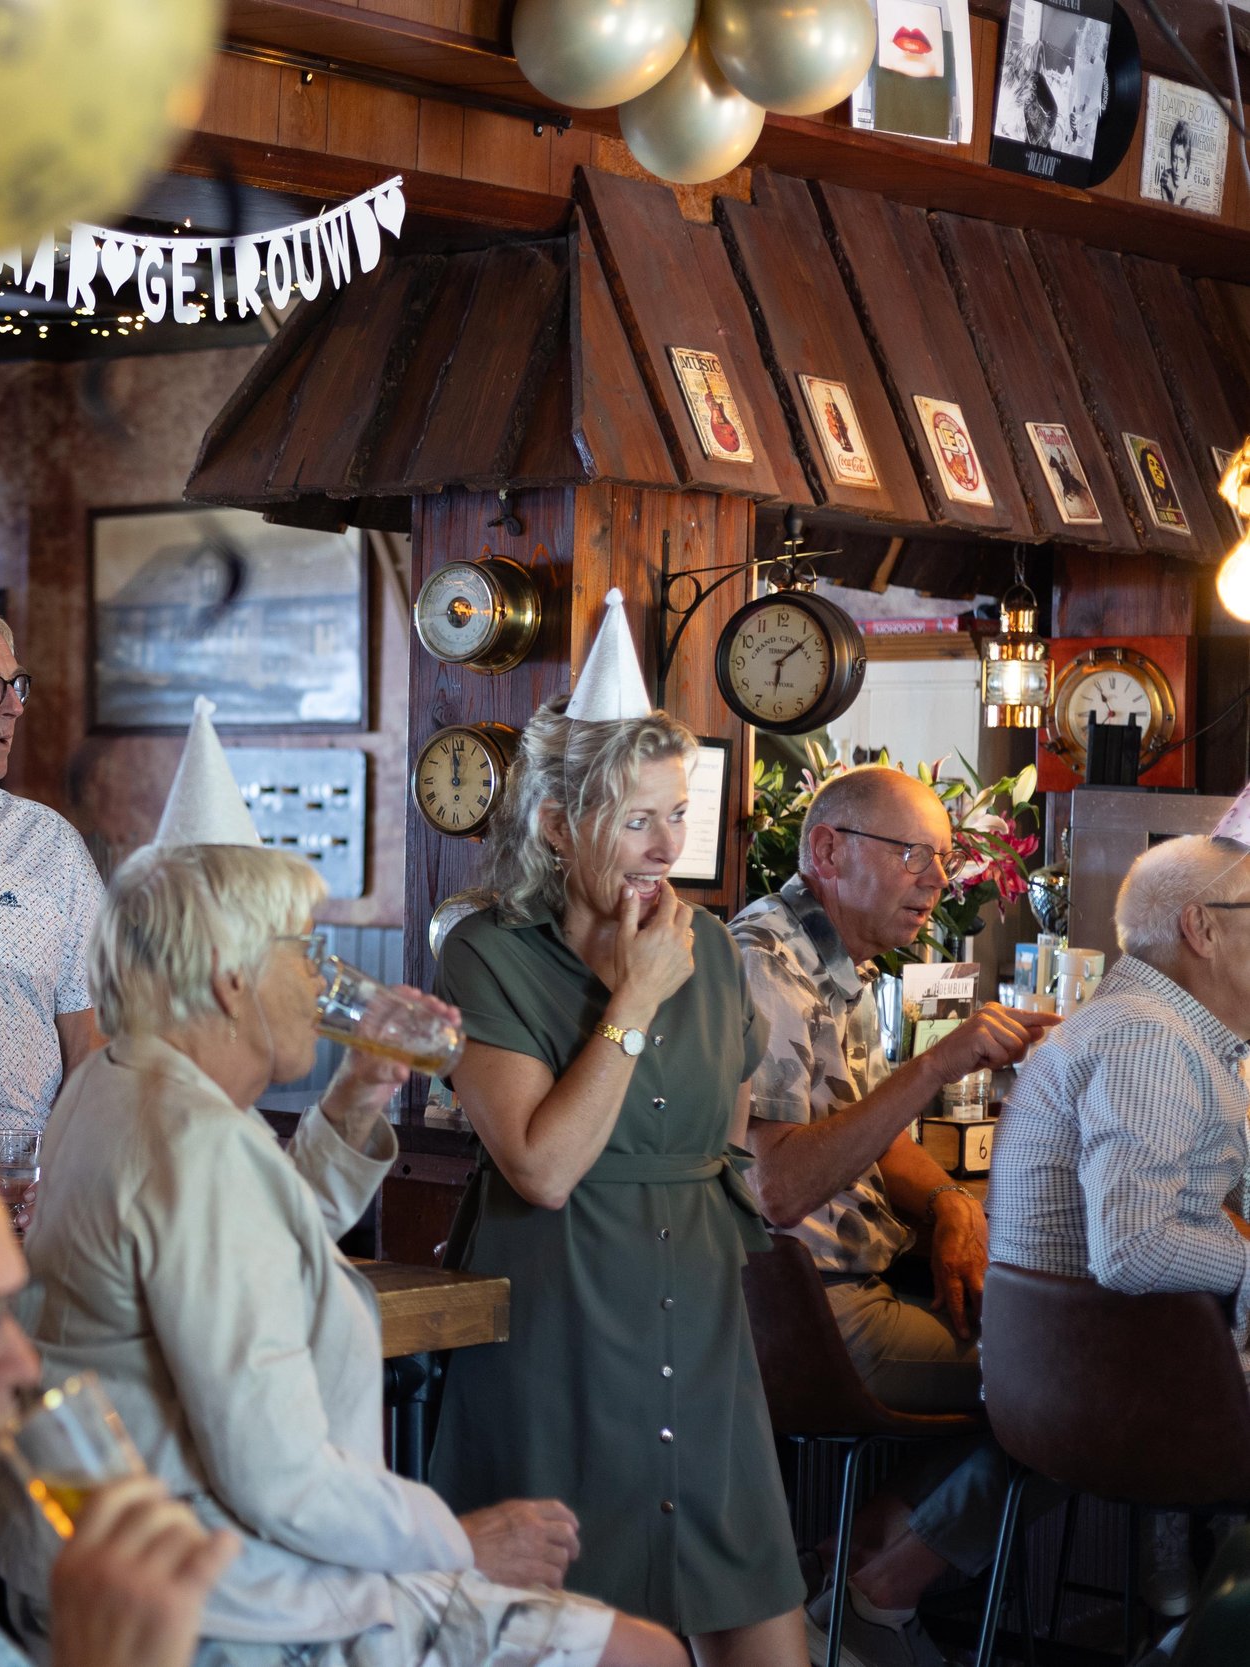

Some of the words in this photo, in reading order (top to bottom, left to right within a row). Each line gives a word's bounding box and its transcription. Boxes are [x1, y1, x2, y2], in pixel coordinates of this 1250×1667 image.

[679, 355, 722, 374] MUSIC
[934, 426, 971, 455] LEO
[758, 619, 766, 633] 11
[777, 612, 790, 627] 12
[802, 621, 807, 635] 1
[872, 621, 926, 636] MONOPOLY
[742, 634, 754, 649] 10
[751, 636, 776, 660] GRAND
[779, 635, 813, 663] CENRAL
[814, 638, 824, 652] 2
[735, 656, 746, 670] 9
[818, 660, 827, 675] 3
[741, 677, 750, 691] 8
[809, 683, 819, 696] 4
[755, 694, 763, 708] 7
[773, 701, 783, 715] 6
[795, 697, 804, 712] 5
[979, 1133, 988, 1160] 6
